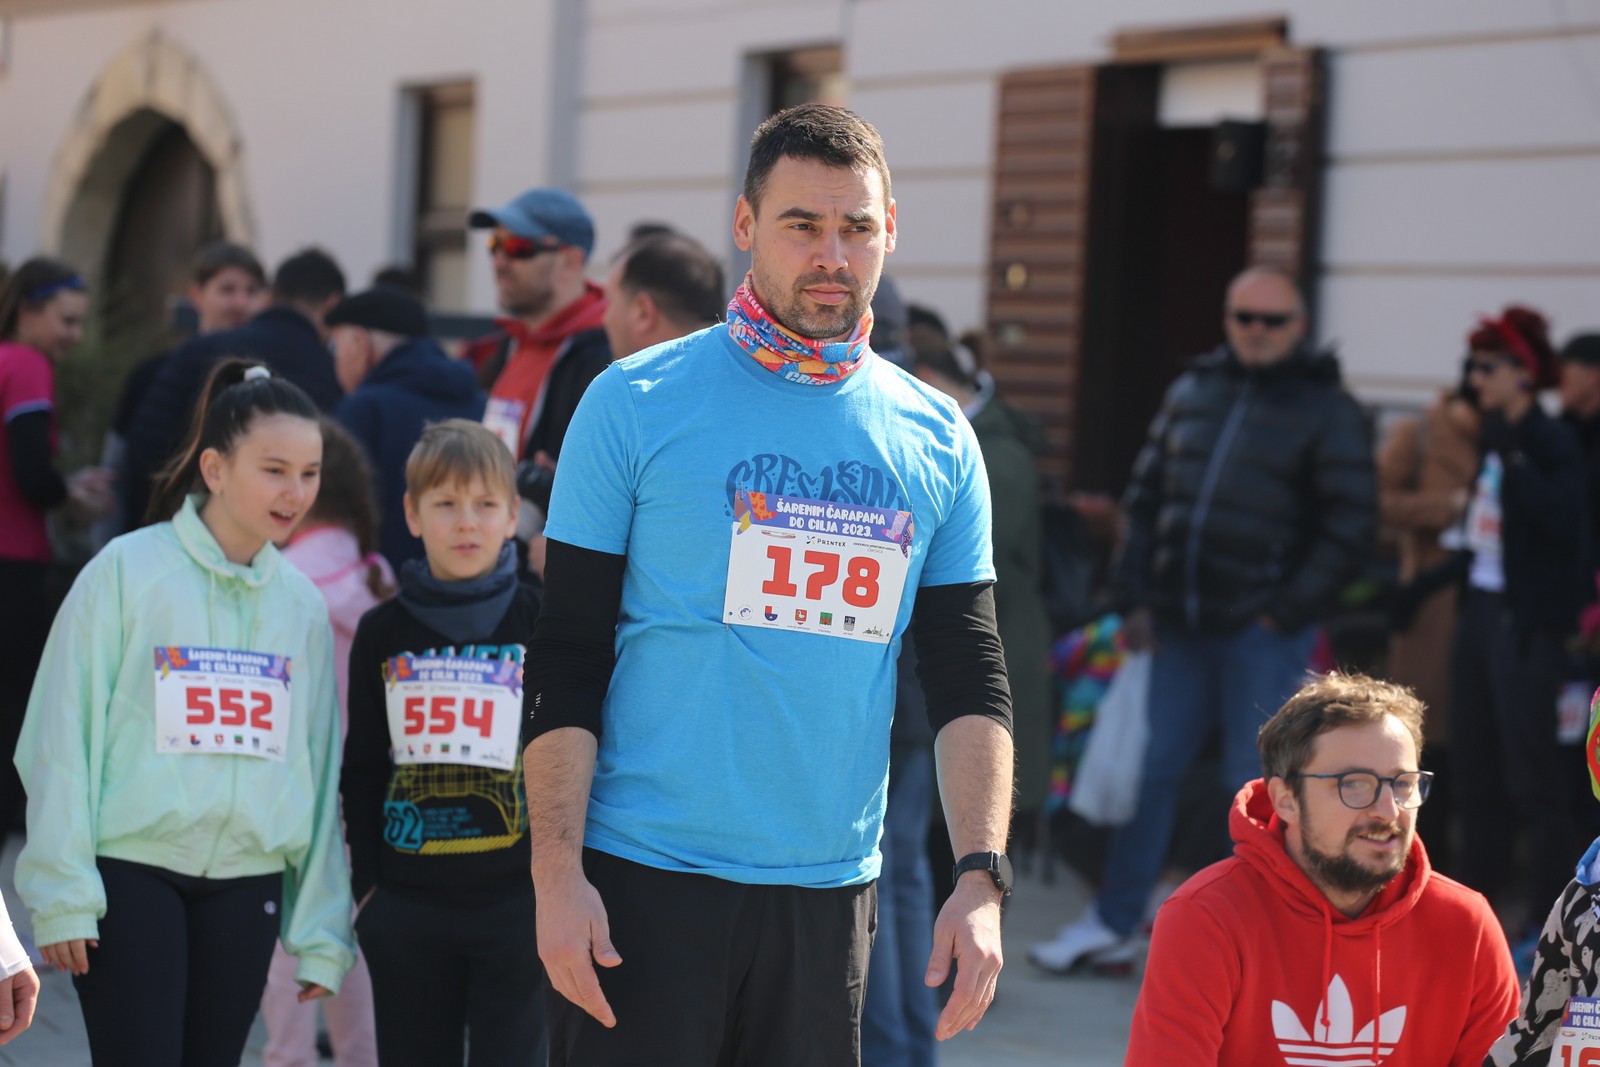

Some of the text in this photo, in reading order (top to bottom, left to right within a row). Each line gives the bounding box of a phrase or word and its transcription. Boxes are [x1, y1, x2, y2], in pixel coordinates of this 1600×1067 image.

[776, 498, 886, 526] ŠARENIM ČARAPAMA
[789, 516, 805, 528] DO
[807, 519, 838, 534] CILJA
[842, 523, 873, 538] 2023.
[761, 545, 880, 609] 178
[186, 686, 273, 732] 552
[404, 696, 494, 738] 554
